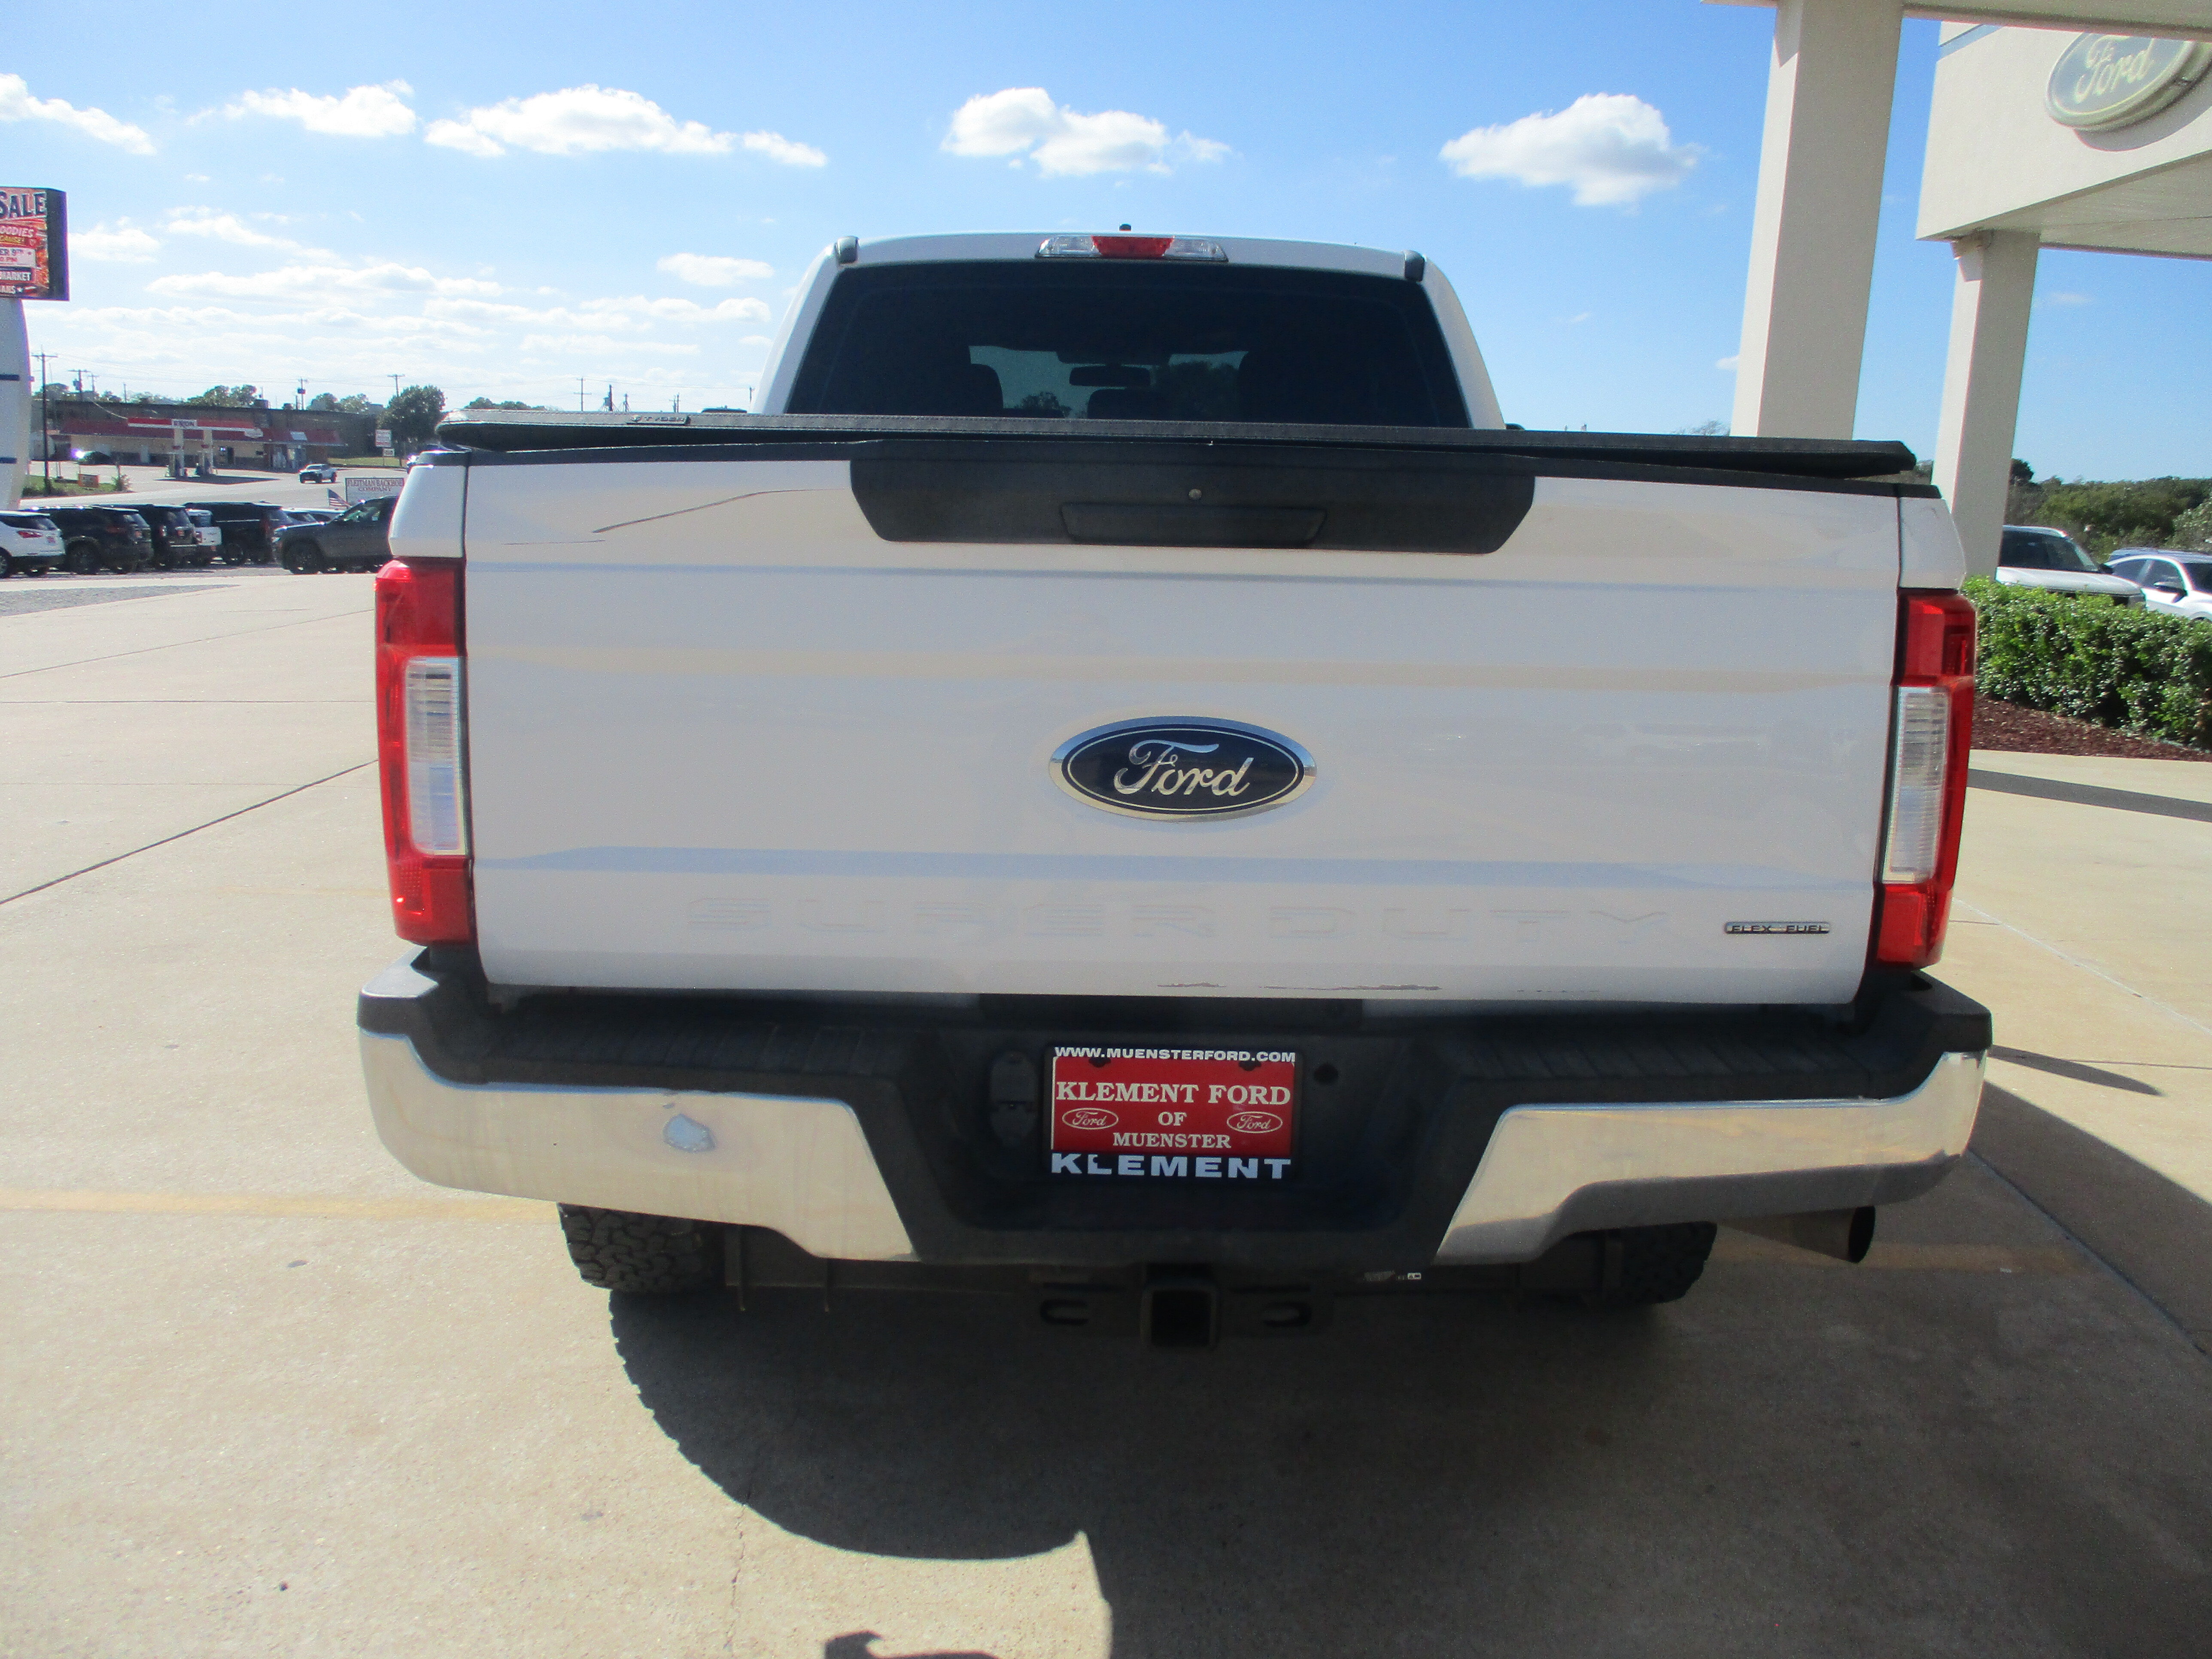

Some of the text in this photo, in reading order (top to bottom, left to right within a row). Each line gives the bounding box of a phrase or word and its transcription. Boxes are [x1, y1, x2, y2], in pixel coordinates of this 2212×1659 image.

[2073, 35, 2155, 104] Ford
[1113, 739, 1255, 797] Ford
[687, 897, 1668, 944] SUPER DUTY
[1732, 925, 1826, 933] FLEX FUEL
[1054, 1047, 1296, 1063] WWW.MUENSTERFORD.COM
[1056, 1081, 1291, 1105] KLEMENT FORD
[1072, 1112, 1107, 1127] Ford
[1158, 1111, 1188, 1127] OF
[1237, 1115, 1271, 1130] Ford
[1112, 1132, 1232, 1149] MUENSTER
[1051, 1152, 1291, 1179] KLEMENT
